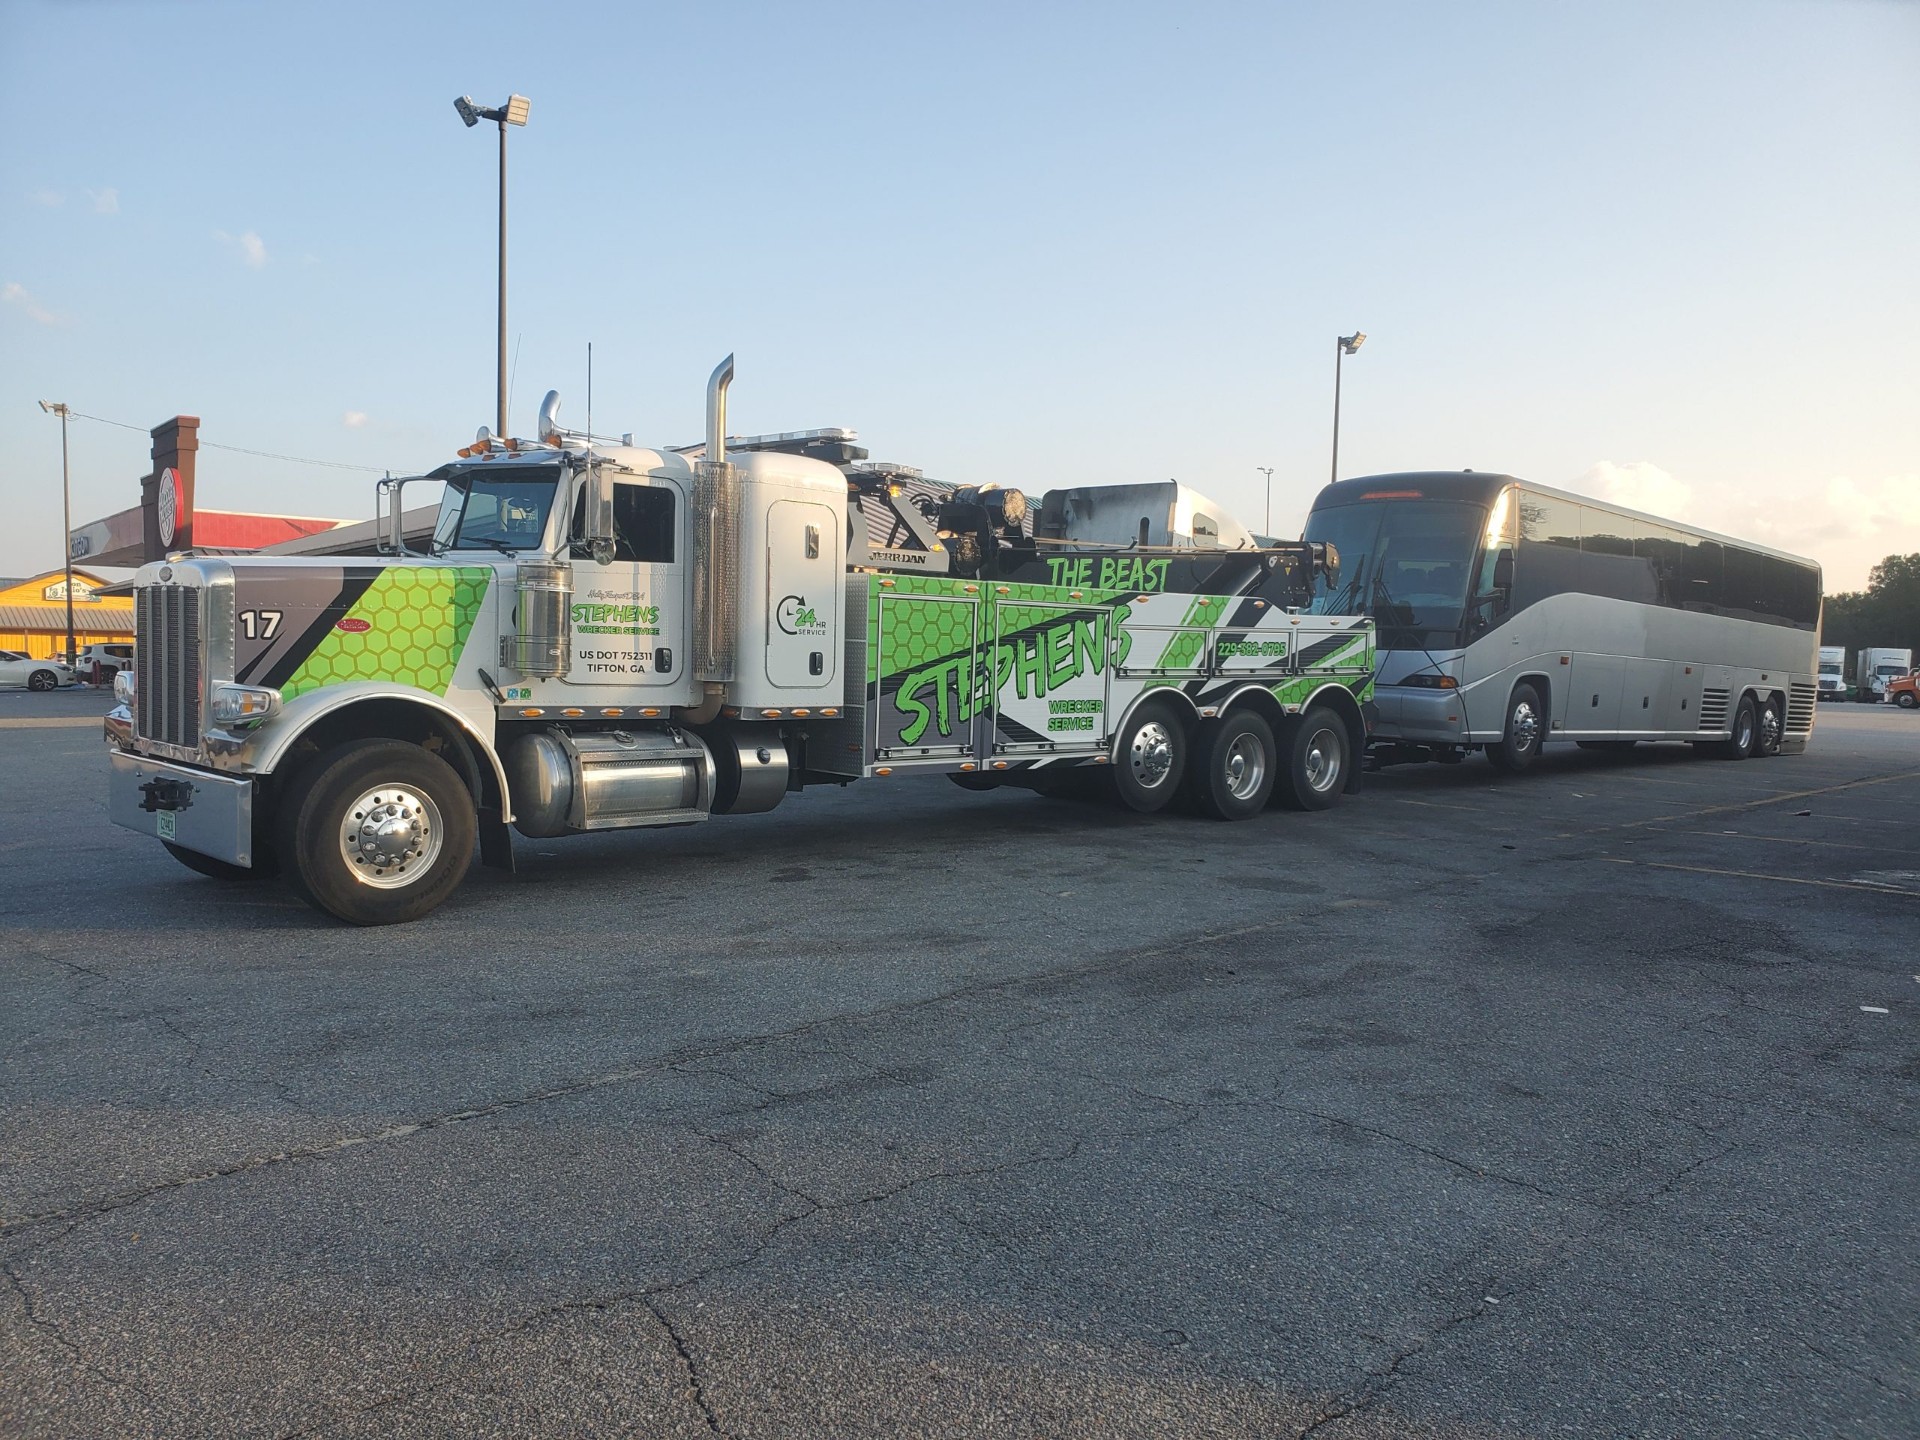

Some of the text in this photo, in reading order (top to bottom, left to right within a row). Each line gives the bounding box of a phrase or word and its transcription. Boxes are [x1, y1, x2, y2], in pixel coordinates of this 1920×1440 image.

[1047, 557, 1173, 592] THE BEAST
[571, 603, 660, 624] STEPHENS
[795, 607, 817, 627] 24
[238, 609, 283, 640] 17
[577, 625, 660, 636] WRECKER SERVICE
[579, 650, 653, 661] US DOT 752311
[587, 664, 645, 673] TIFTON, GA
[895, 604, 1132, 746] STEPHENS
[1048, 700, 1103, 714] WRECKER
[1047, 717, 1093, 731] SERVICE
